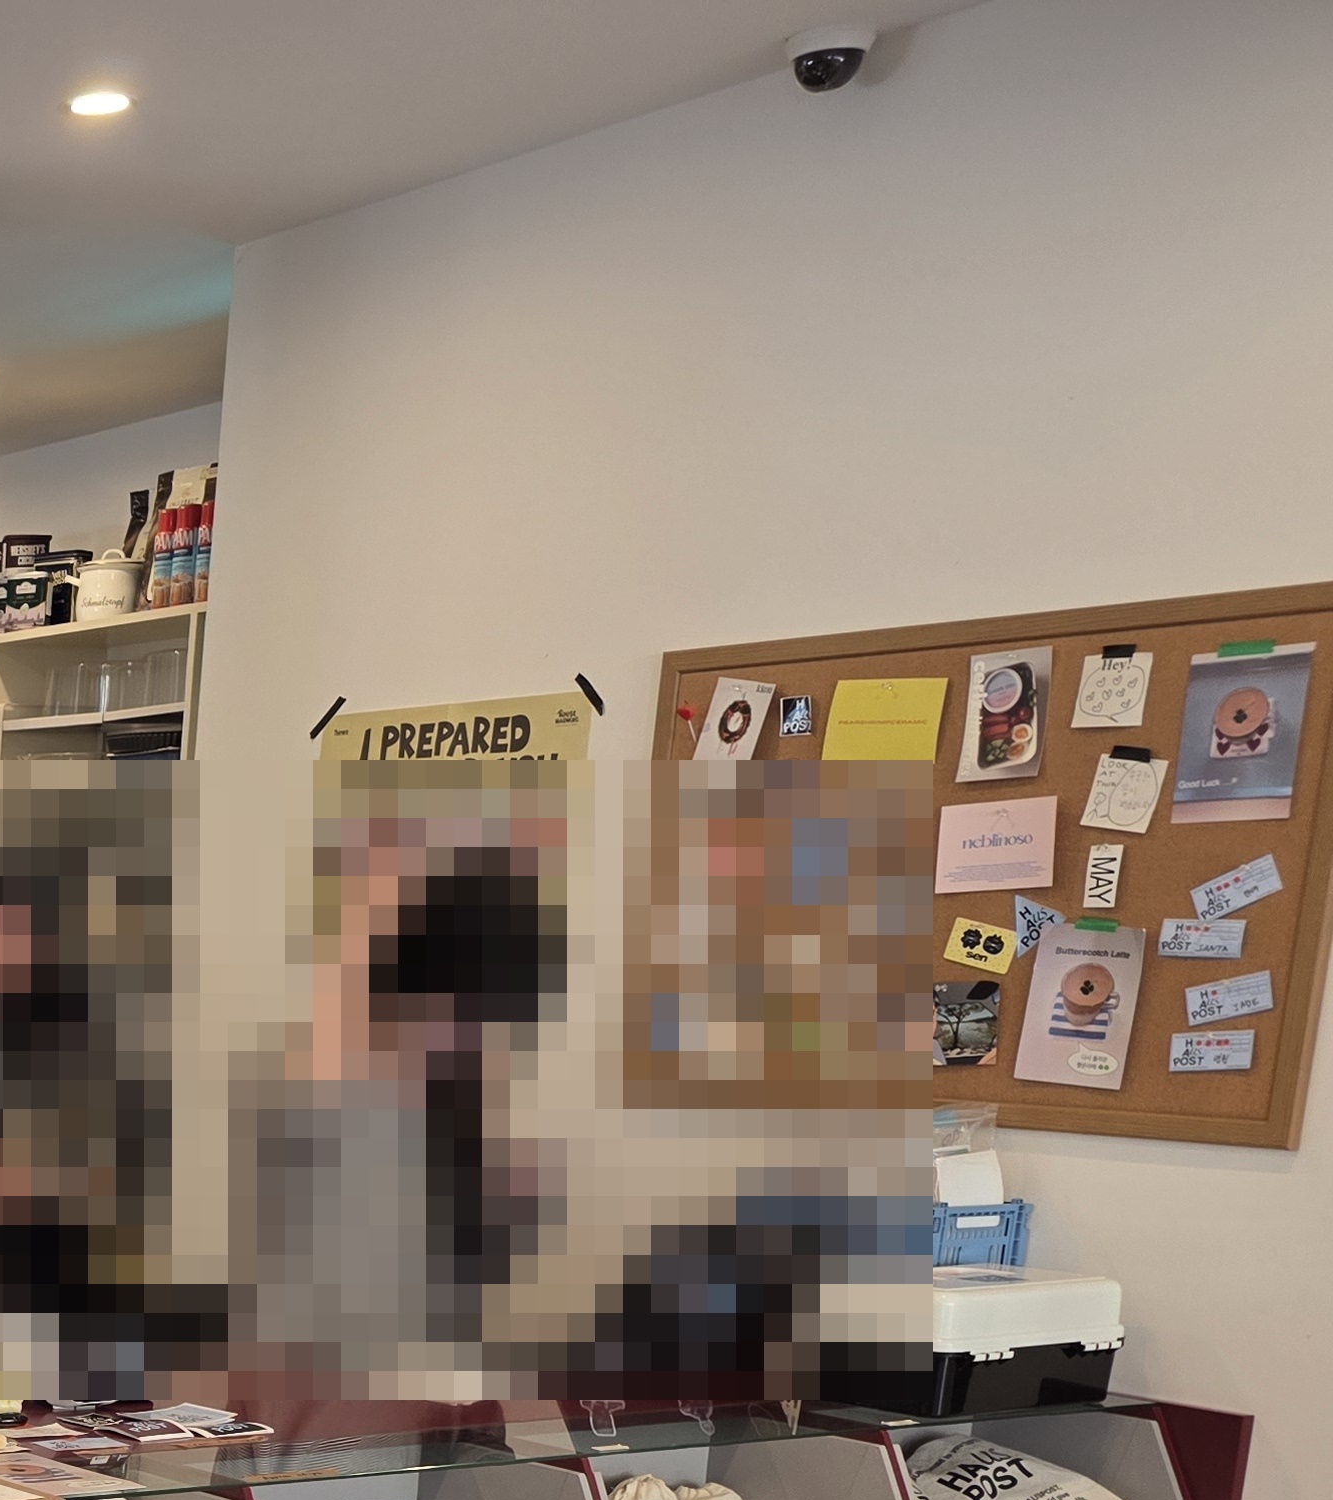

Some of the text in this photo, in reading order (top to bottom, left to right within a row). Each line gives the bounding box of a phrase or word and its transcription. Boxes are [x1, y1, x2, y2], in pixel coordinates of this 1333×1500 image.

[1101, 658, 1132, 671] Hey!
[381, 714, 530, 755] PREPARED
[1101, 760, 1128, 770] LOOK
[1178, 779, 1220, 789] Good Luck
[1088, 857, 1118, 904] MAY
[1200, 899, 1231, 920] POST
[1055, 946, 1109, 958] Butterscotch
[1161, 941, 1192, 951] POST
[966, 951, 988, 963] sen
[1191, 1005, 1223, 1020] POST
[1173, 1056, 1204, 1067] POST
[937, 1447, 1011, 1492] HAUS
